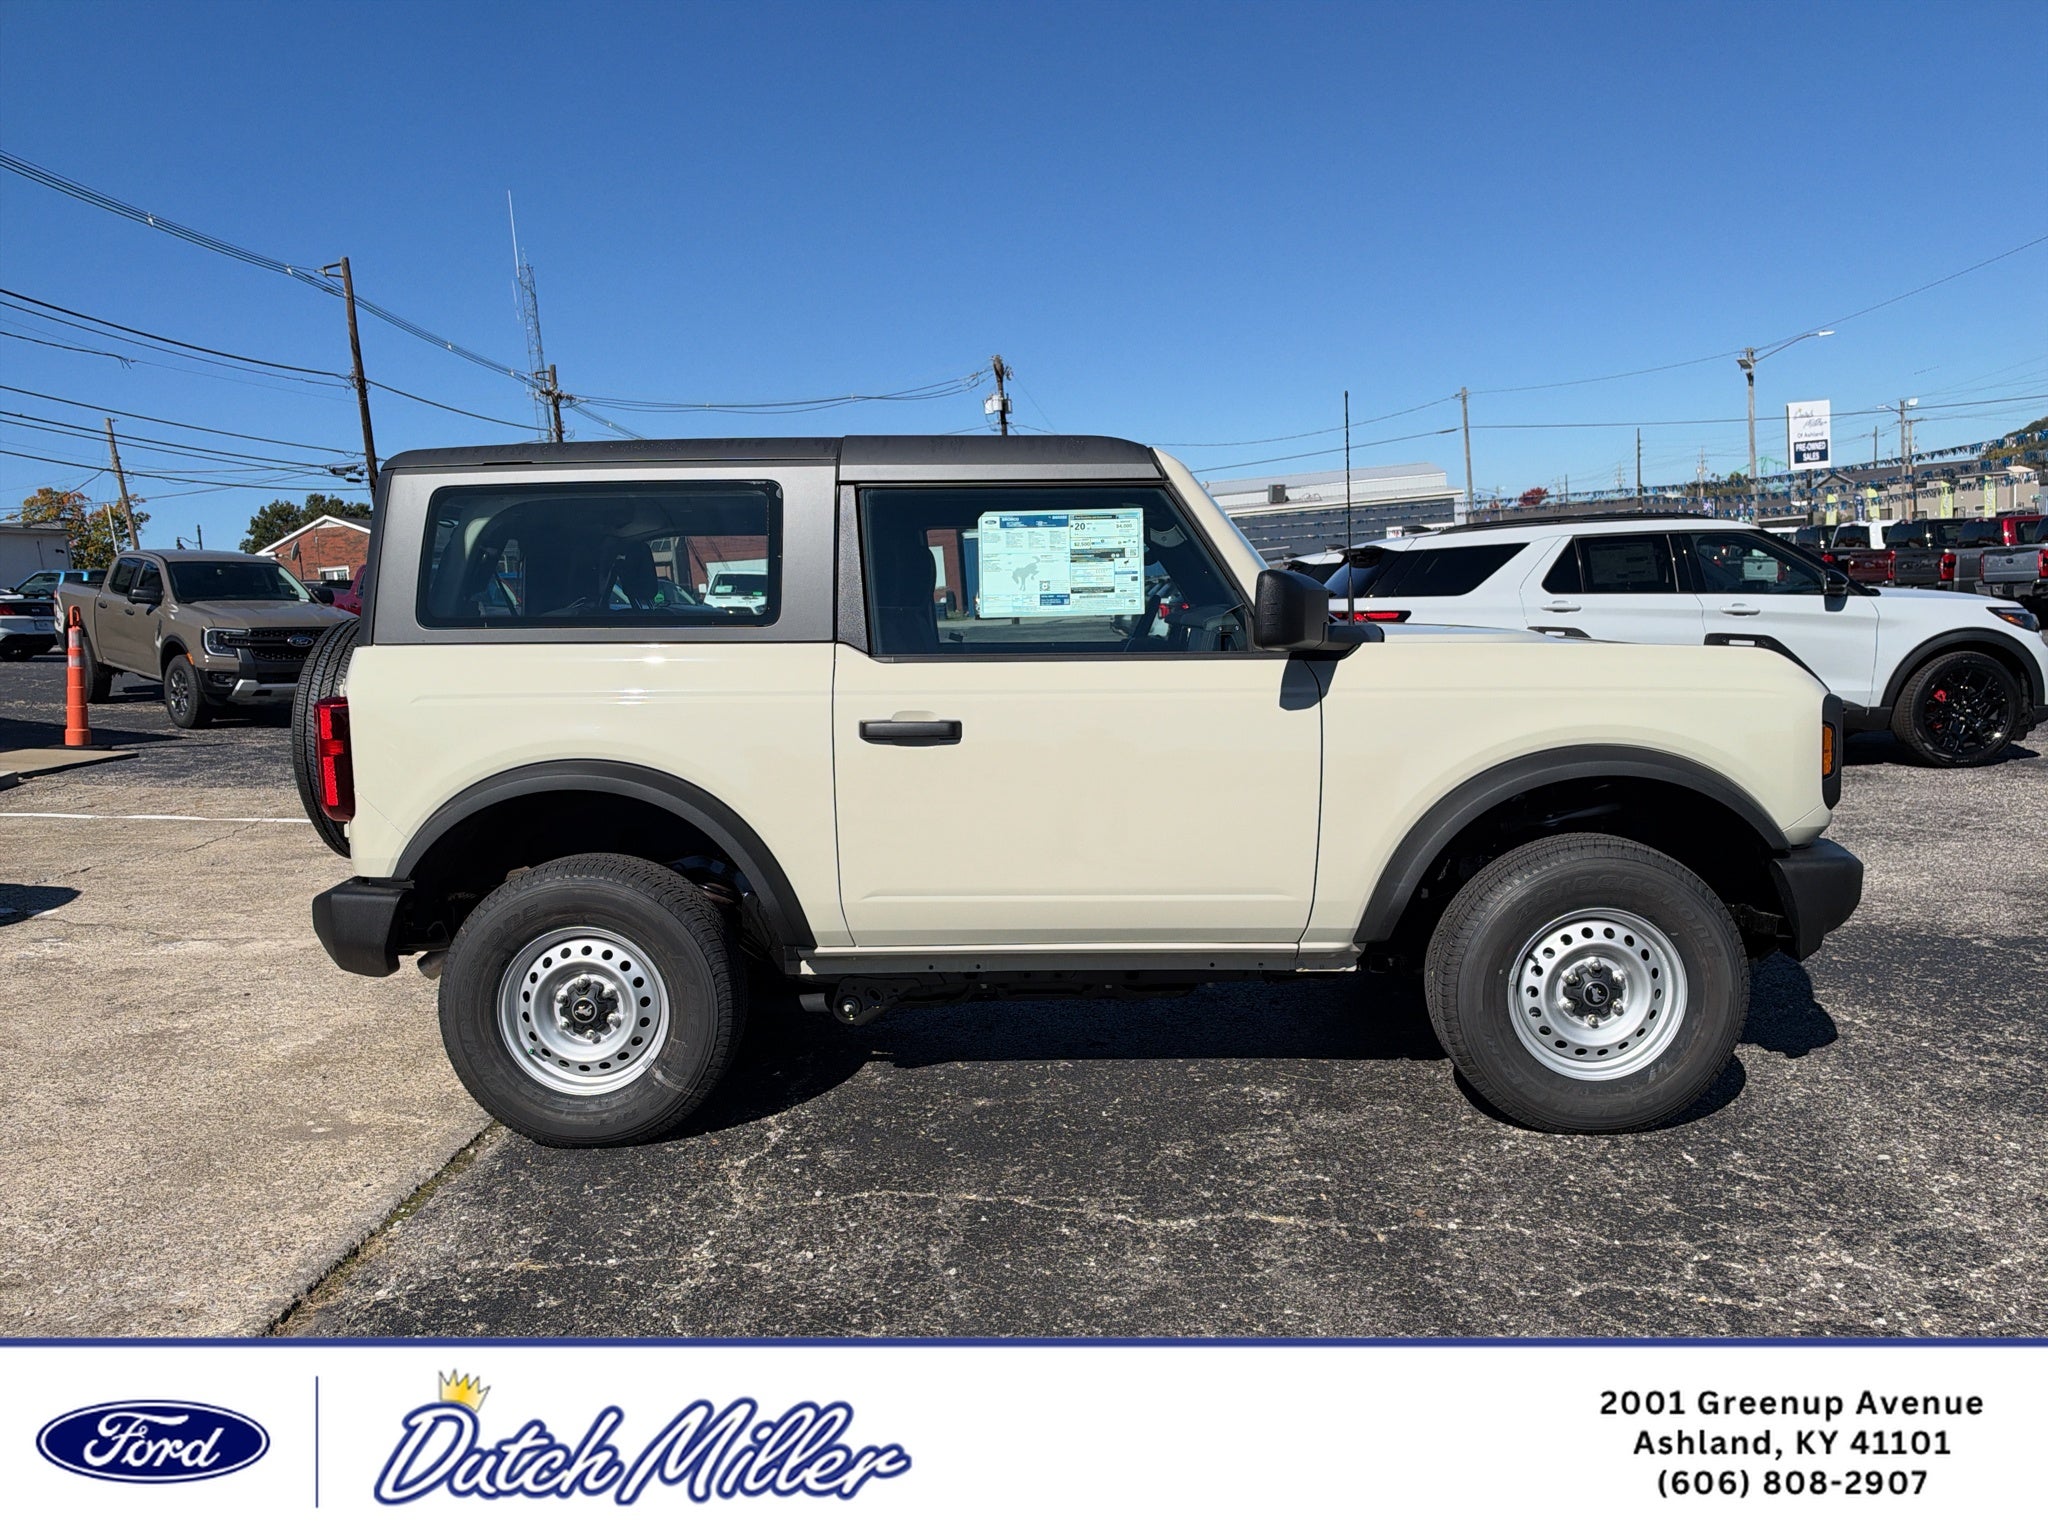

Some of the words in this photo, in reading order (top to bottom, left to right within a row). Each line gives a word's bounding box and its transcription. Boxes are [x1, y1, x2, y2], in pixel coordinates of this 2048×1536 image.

[1796, 441, 1826, 451] PRE-OWNED
[1803, 451, 1820, 461] SALES
[1074, 522, 1086, 531] 20
